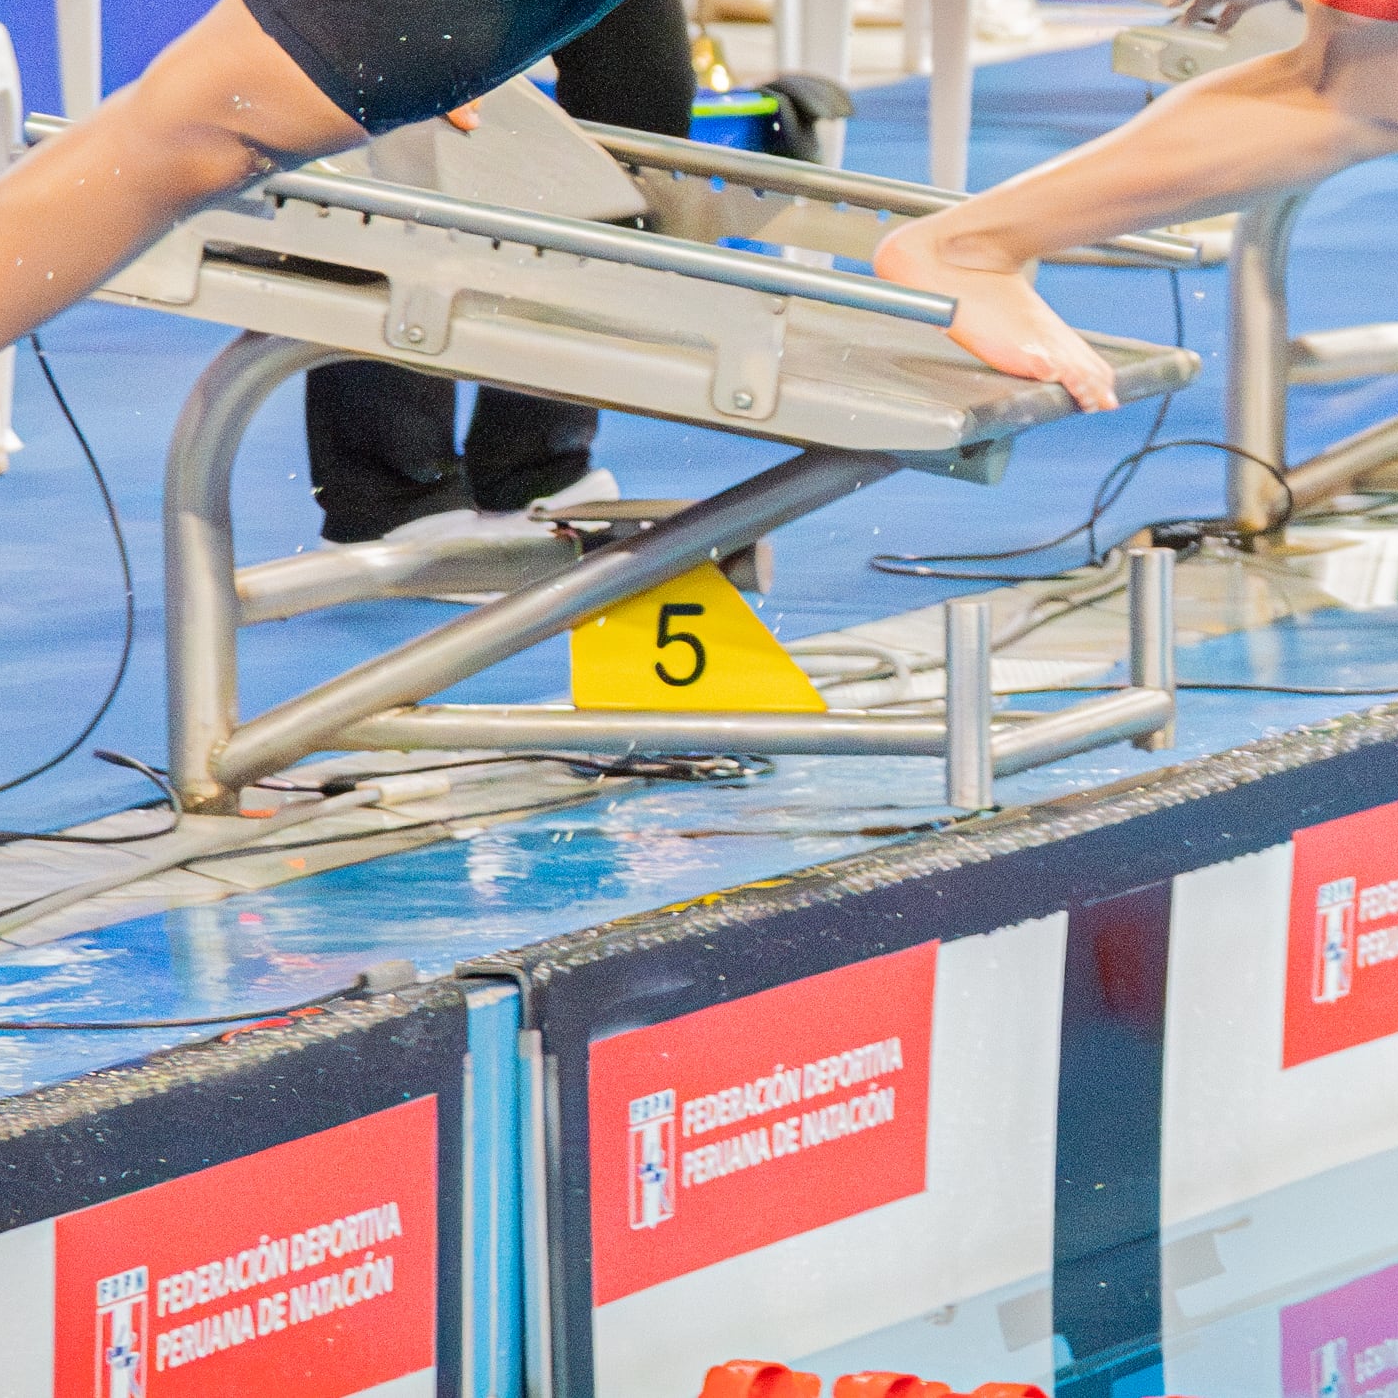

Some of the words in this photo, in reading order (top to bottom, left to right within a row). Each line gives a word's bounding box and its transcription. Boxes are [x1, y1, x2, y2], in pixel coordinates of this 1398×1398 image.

[654, 602, 707, 687] 5
[681, 1063, 802, 1138] FEDERACIÓN
[802, 1036, 904, 1098] DEPORTIVA
[681, 1126, 773, 1189] PERUANA
[772, 1117, 800, 1158] DE
[801, 1082, 896, 1149] NATACIÓN
[155, 1304, 256, 1372] PERUANA
[257, 1291, 288, 1337] DE
[290, 1251, 394, 1325] NATACIÓN
[156, 1235, 289, 1318] FEDERACIÓN
[290, 1201, 403, 1273] DEPORTIVA
